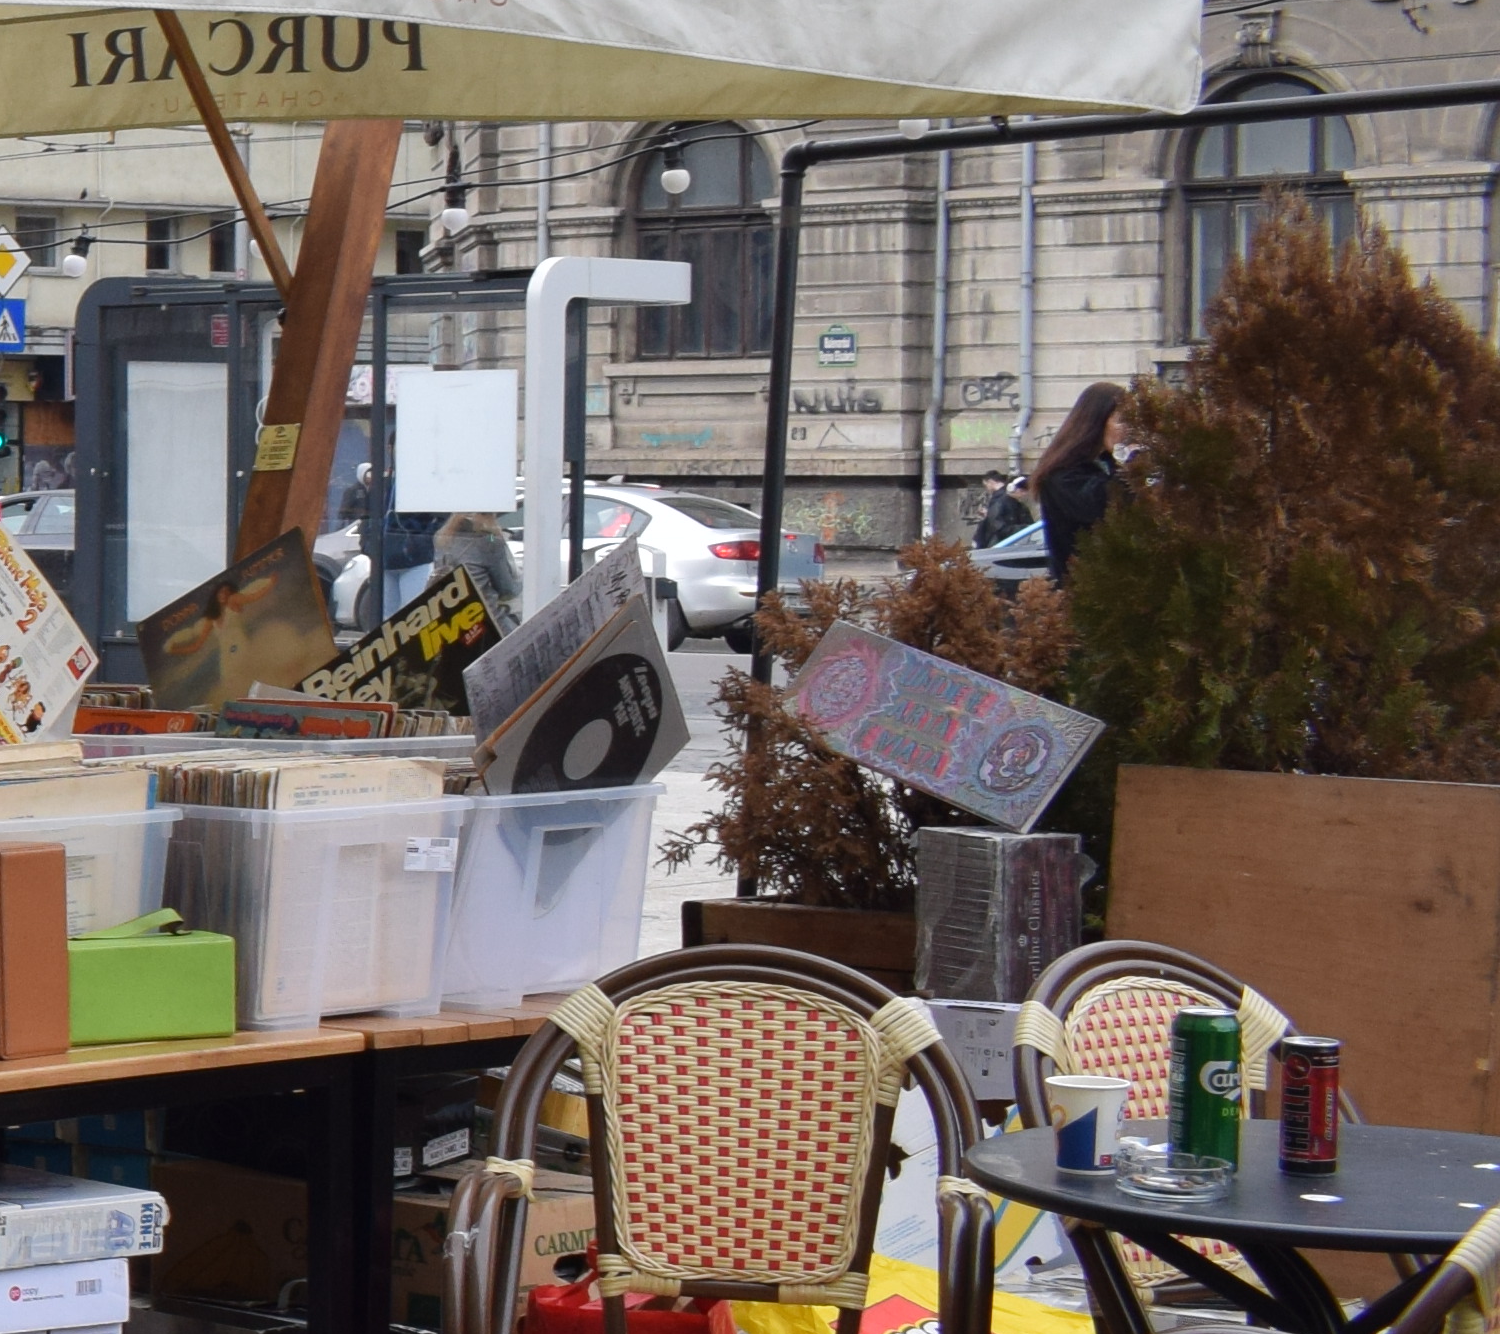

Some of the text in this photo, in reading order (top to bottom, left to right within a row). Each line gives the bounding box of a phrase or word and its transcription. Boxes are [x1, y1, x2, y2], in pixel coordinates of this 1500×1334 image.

[16, 603, 39, 634] 2
[301, 568, 469, 701] Reinhard
[419, 601, 486, 662] live
[1027, 869, 1041, 985] erline Classics
